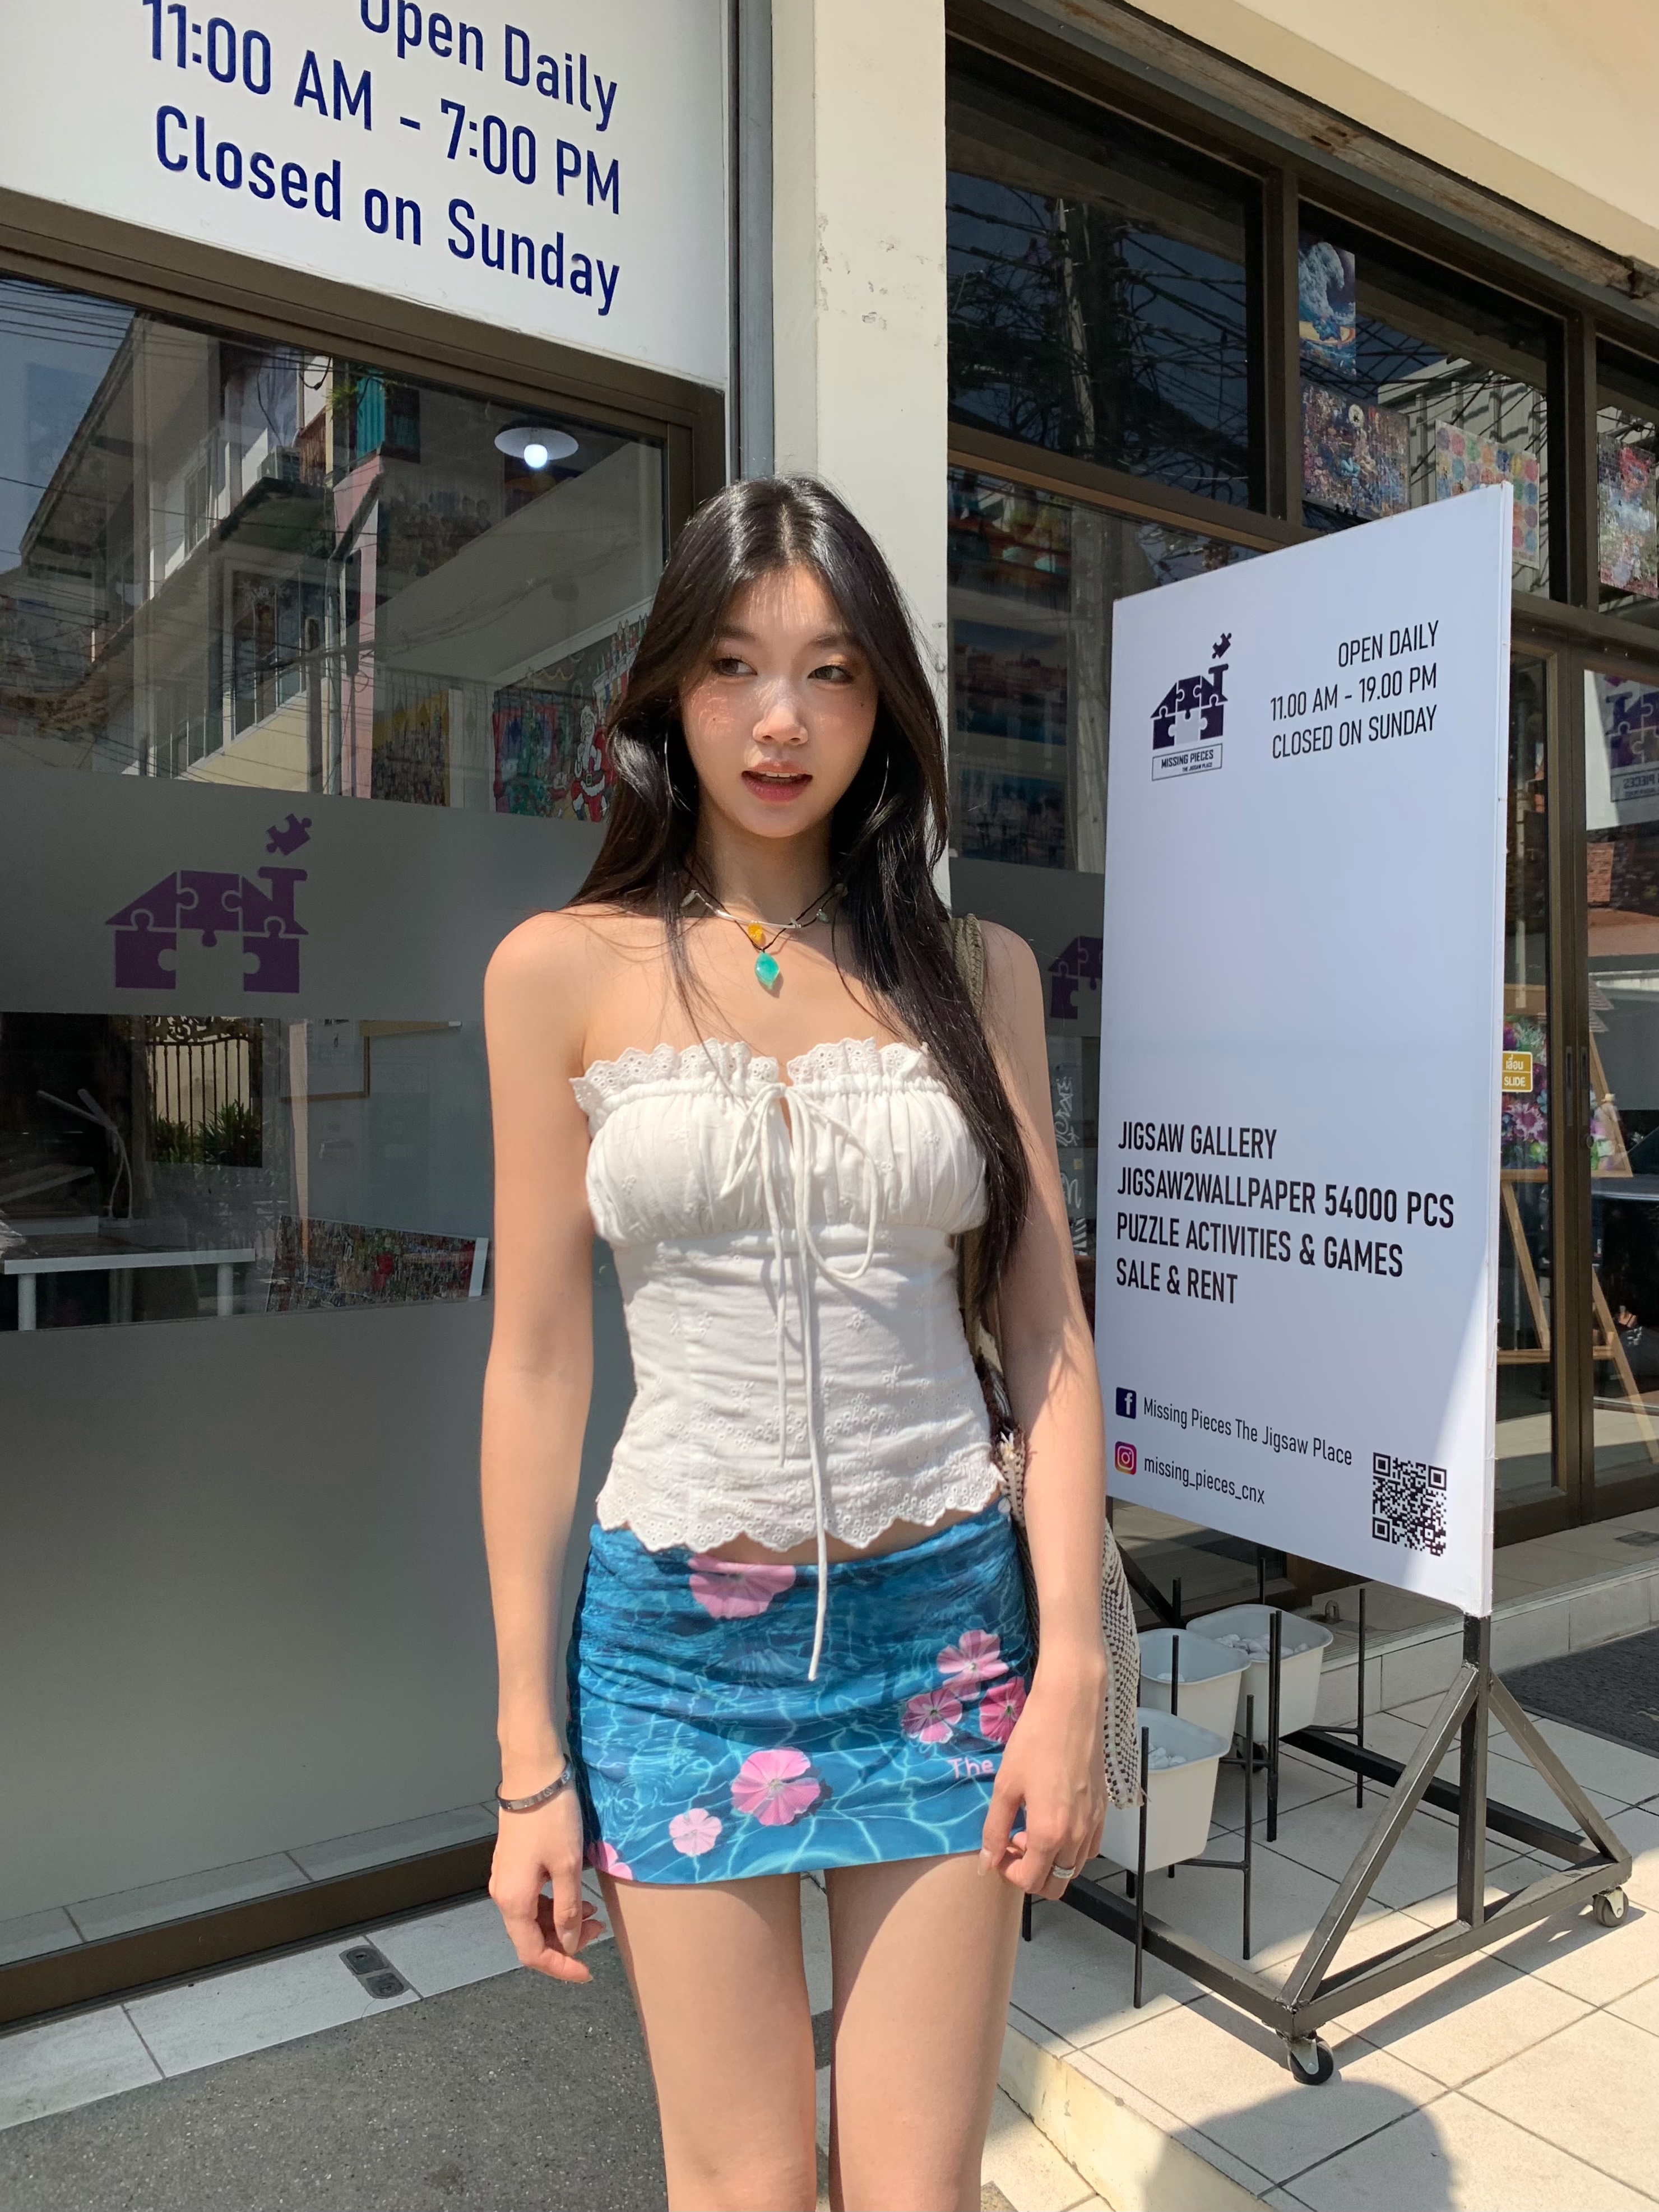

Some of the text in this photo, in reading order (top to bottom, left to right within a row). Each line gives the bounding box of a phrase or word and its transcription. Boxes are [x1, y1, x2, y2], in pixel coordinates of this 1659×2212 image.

[506, 24, 617, 131] Daily
[143, 0, 619, 215] 11:00 AM - 7:00 PM
[157, 105, 619, 316] Closed on Sunday
[1339, 620, 1438, 667] OPEN DAILY
[1271, 692, 1306, 721] 11.00
[1313, 684, 1337, 713] AM
[1359, 671, 1402, 703] 19.00
[1410, 663, 1436, 693] PM
[1273, 704, 1436, 758] CLOSED ON SUNDAY
[1161, 749, 1213, 768] MISSING PIECES
[1504, 1076, 1526, 1087] SLIDE
[1118, 1121, 1277, 1159] JIGSAW GALLERY
[1117, 1167, 1315, 1214] JIGSAW2WALLPAPER
[1325, 1184, 1397, 1222] 54000
[1407, 1191, 1453, 1228] PCS
[1118, 1212, 1402, 1277] PUZZLE ACTIVITIES & GAMES
[1116, 1258, 1238, 1304] SALE & RENT
[1144, 1397, 1351, 1465] Missing Pieces The Jigsaw Place
[1144, 1457, 1264, 1504] missing_pieces_cnx
[947, 1757, 994, 1779] The
